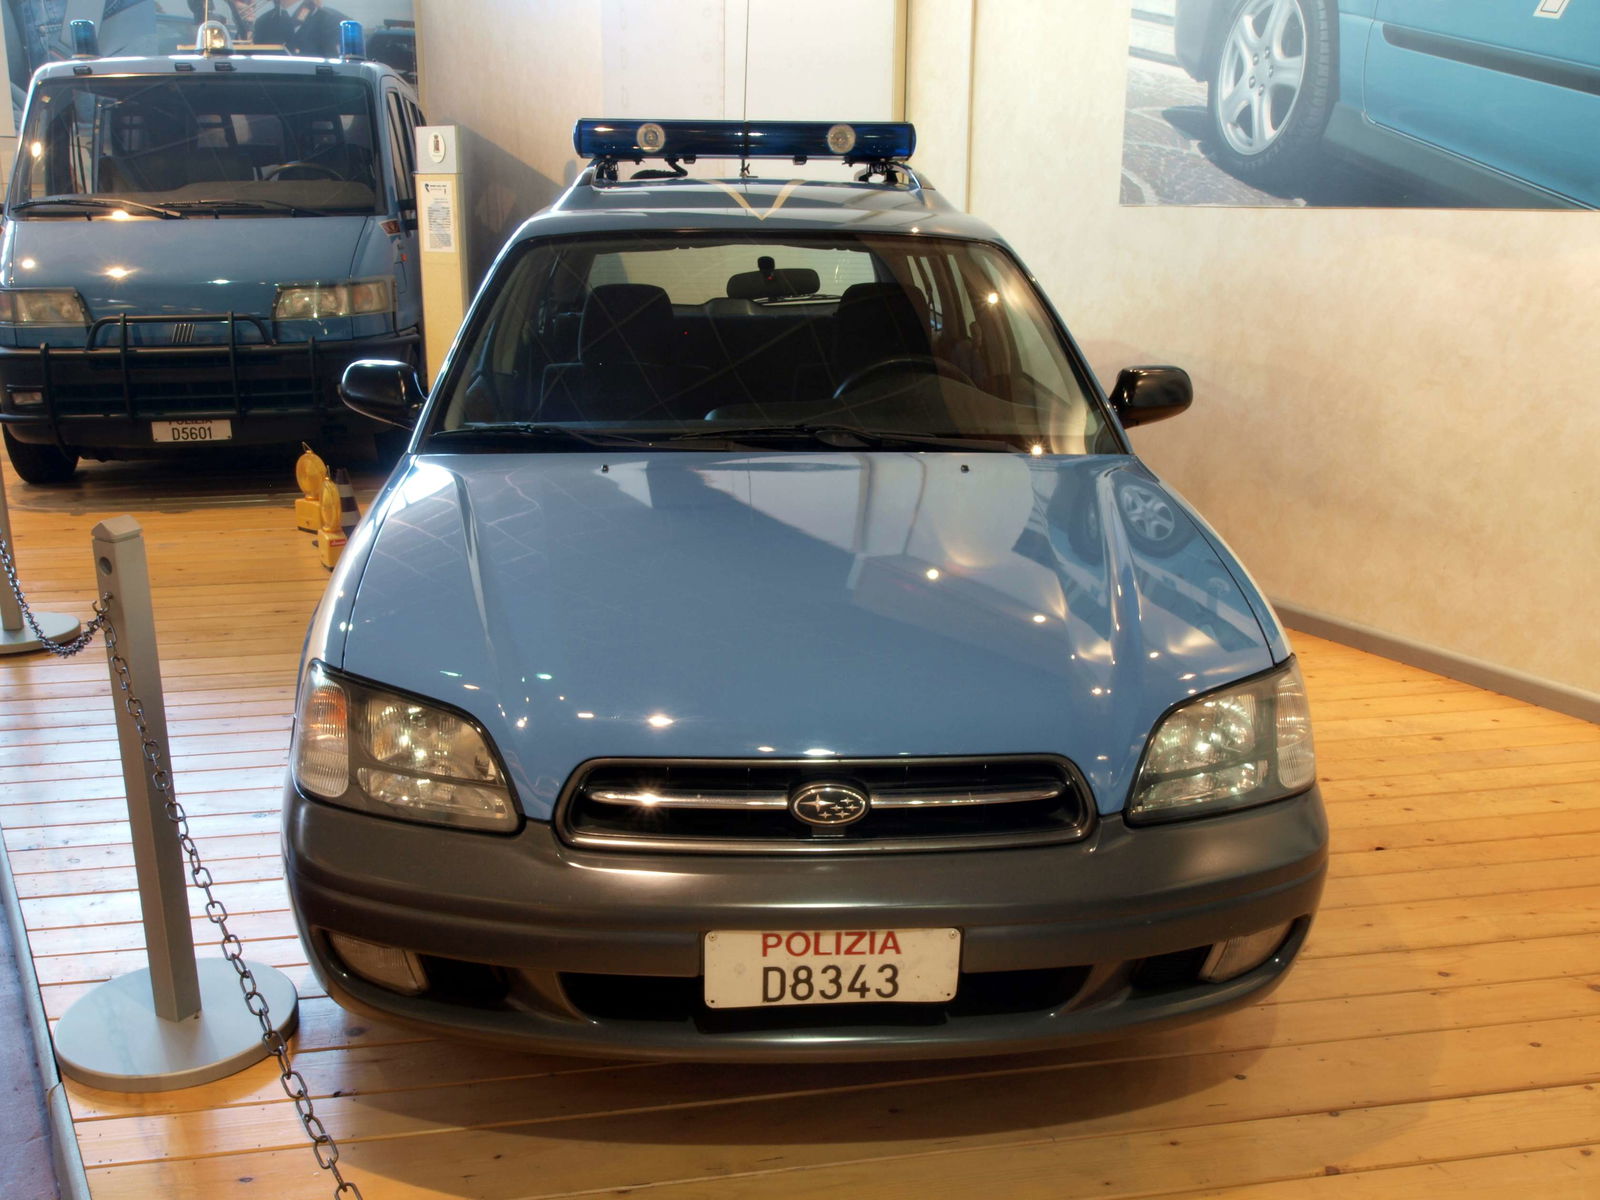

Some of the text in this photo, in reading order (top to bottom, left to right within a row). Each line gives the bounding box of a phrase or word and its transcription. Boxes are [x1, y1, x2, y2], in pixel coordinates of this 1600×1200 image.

[171, 426, 212, 440] D5601
[761, 931, 902, 957] POLIZIA
[762, 963, 900, 1003] D8343
